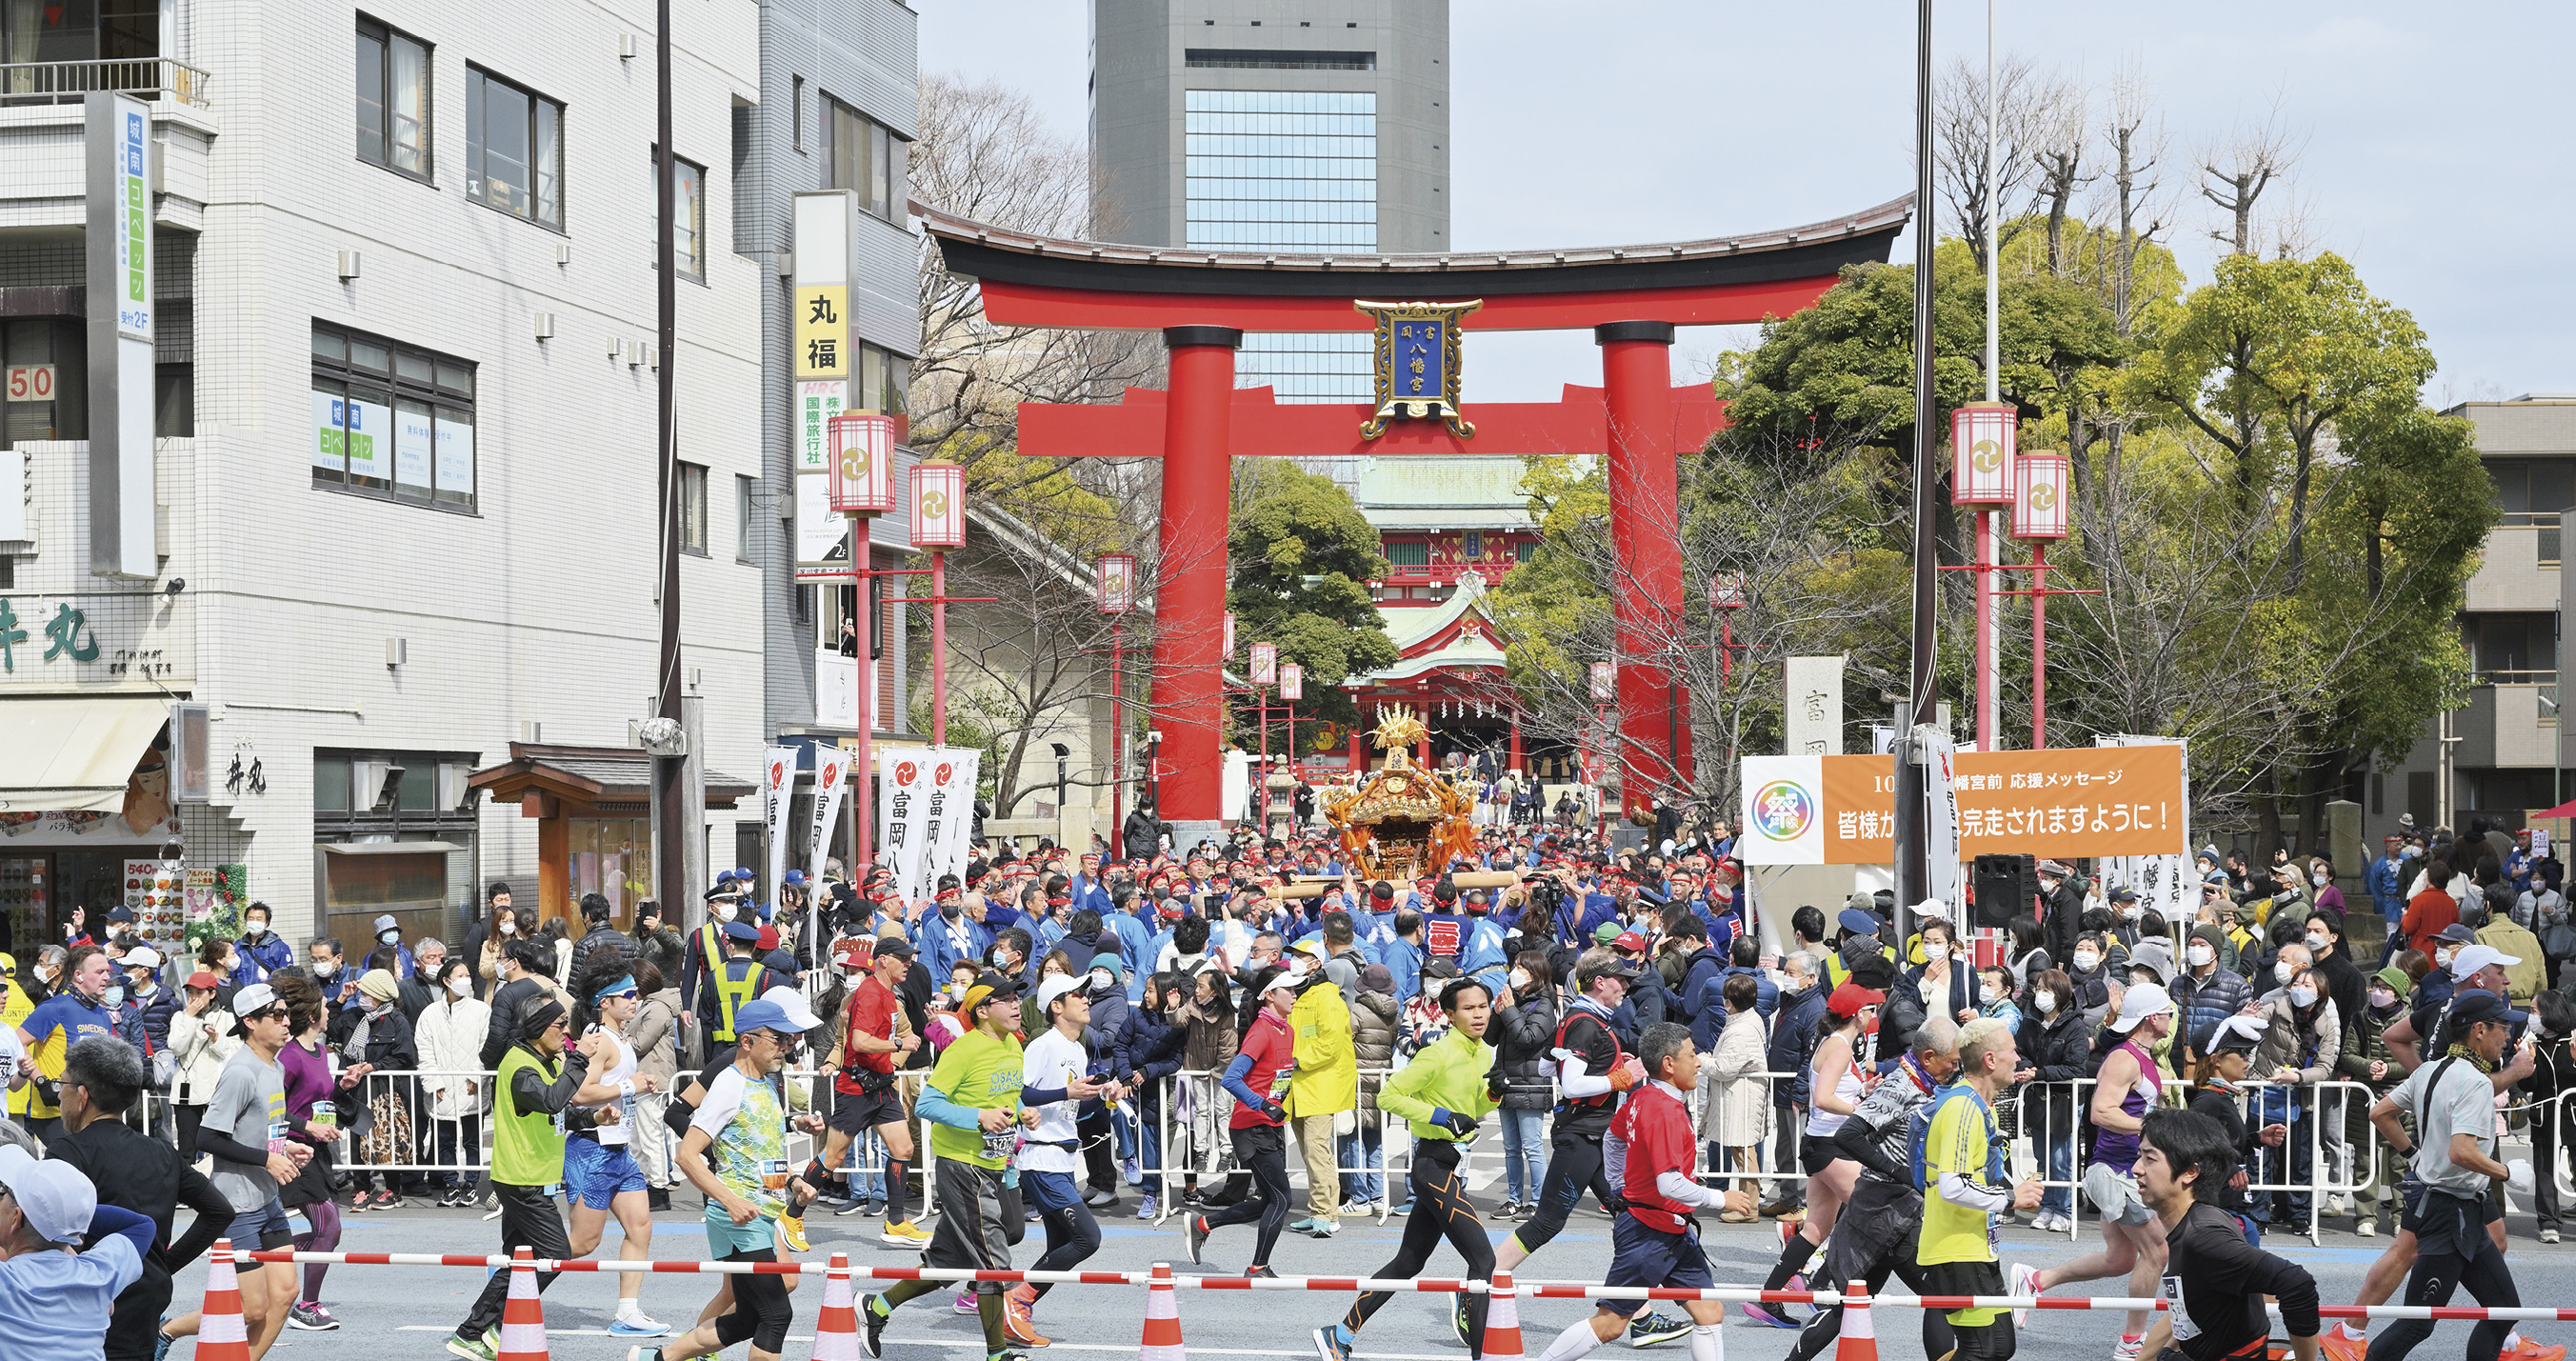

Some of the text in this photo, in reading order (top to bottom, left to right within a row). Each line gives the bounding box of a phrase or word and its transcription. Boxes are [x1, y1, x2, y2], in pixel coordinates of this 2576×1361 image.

[129, 116, 144, 297] 城南コベッツ
[121, 310, 149, 330] 受付2F
[809, 294, 837, 370] 丸福
[10, 368, 52, 397] 50
[804, 381, 842, 394] HRC
[333, 405, 360, 426] 城南
[806, 396, 820, 465] 国際旅行社
[322, 433, 371, 455] コベッツ
[834, 543, 847, 557] 2F
[2009, 769, 2124, 790] 応援メッセージ
[76, 1024, 109, 1035] SWEDEN
[990, 1069, 1024, 1086] OSAKA
